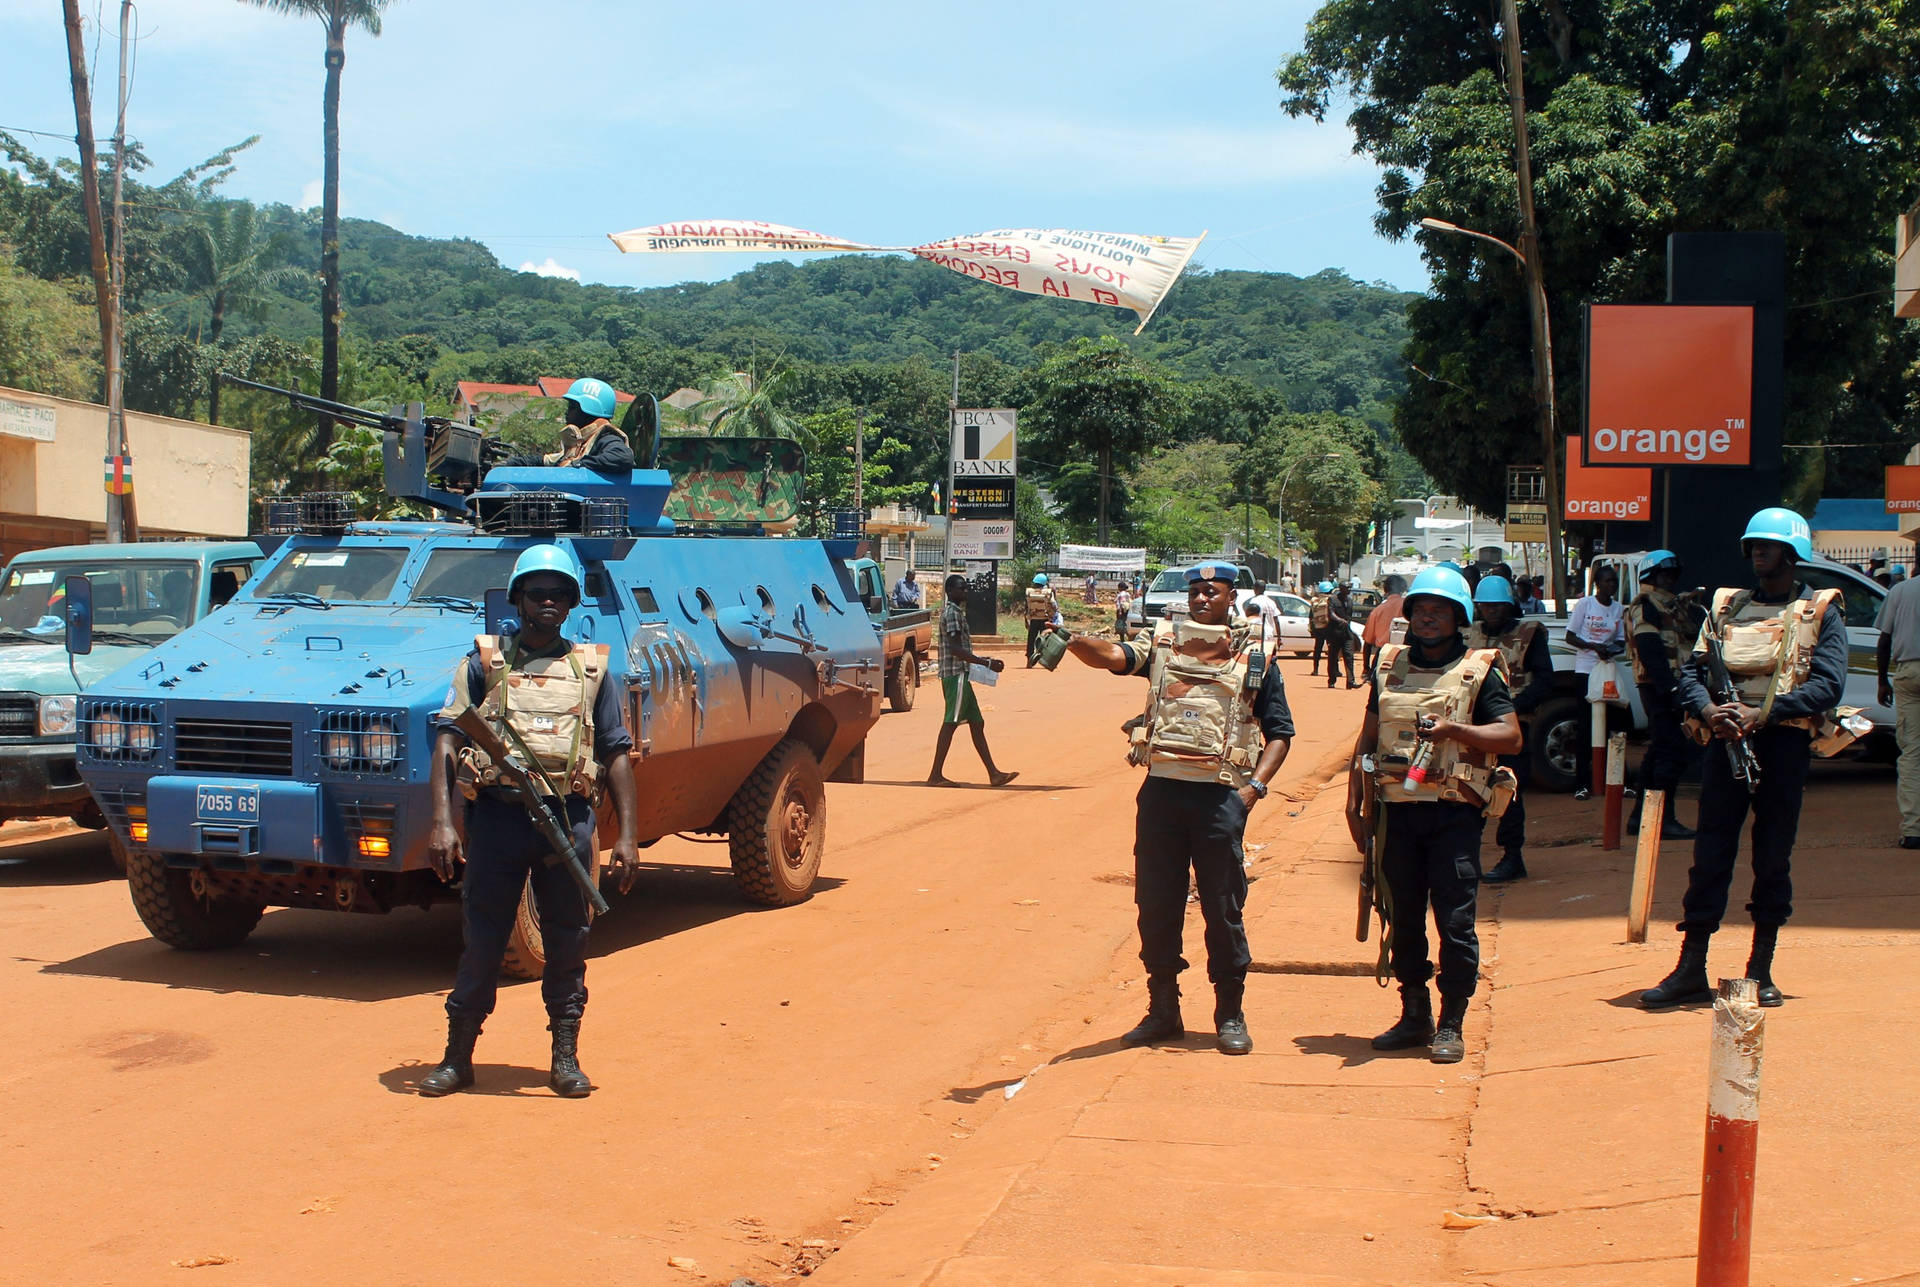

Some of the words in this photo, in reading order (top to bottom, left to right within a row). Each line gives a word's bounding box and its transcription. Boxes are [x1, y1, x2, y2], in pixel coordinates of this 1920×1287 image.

[582, 381, 601, 396] UN
[1594, 428, 1731, 461] orange
[1725, 418, 1745, 429] TM
[954, 460, 1011, 475] BANK
[1567, 499, 1640, 519] orange
[641, 639, 694, 707] UN
[199, 794, 233, 811] 7055
[238, 796, 257, 812] G9
